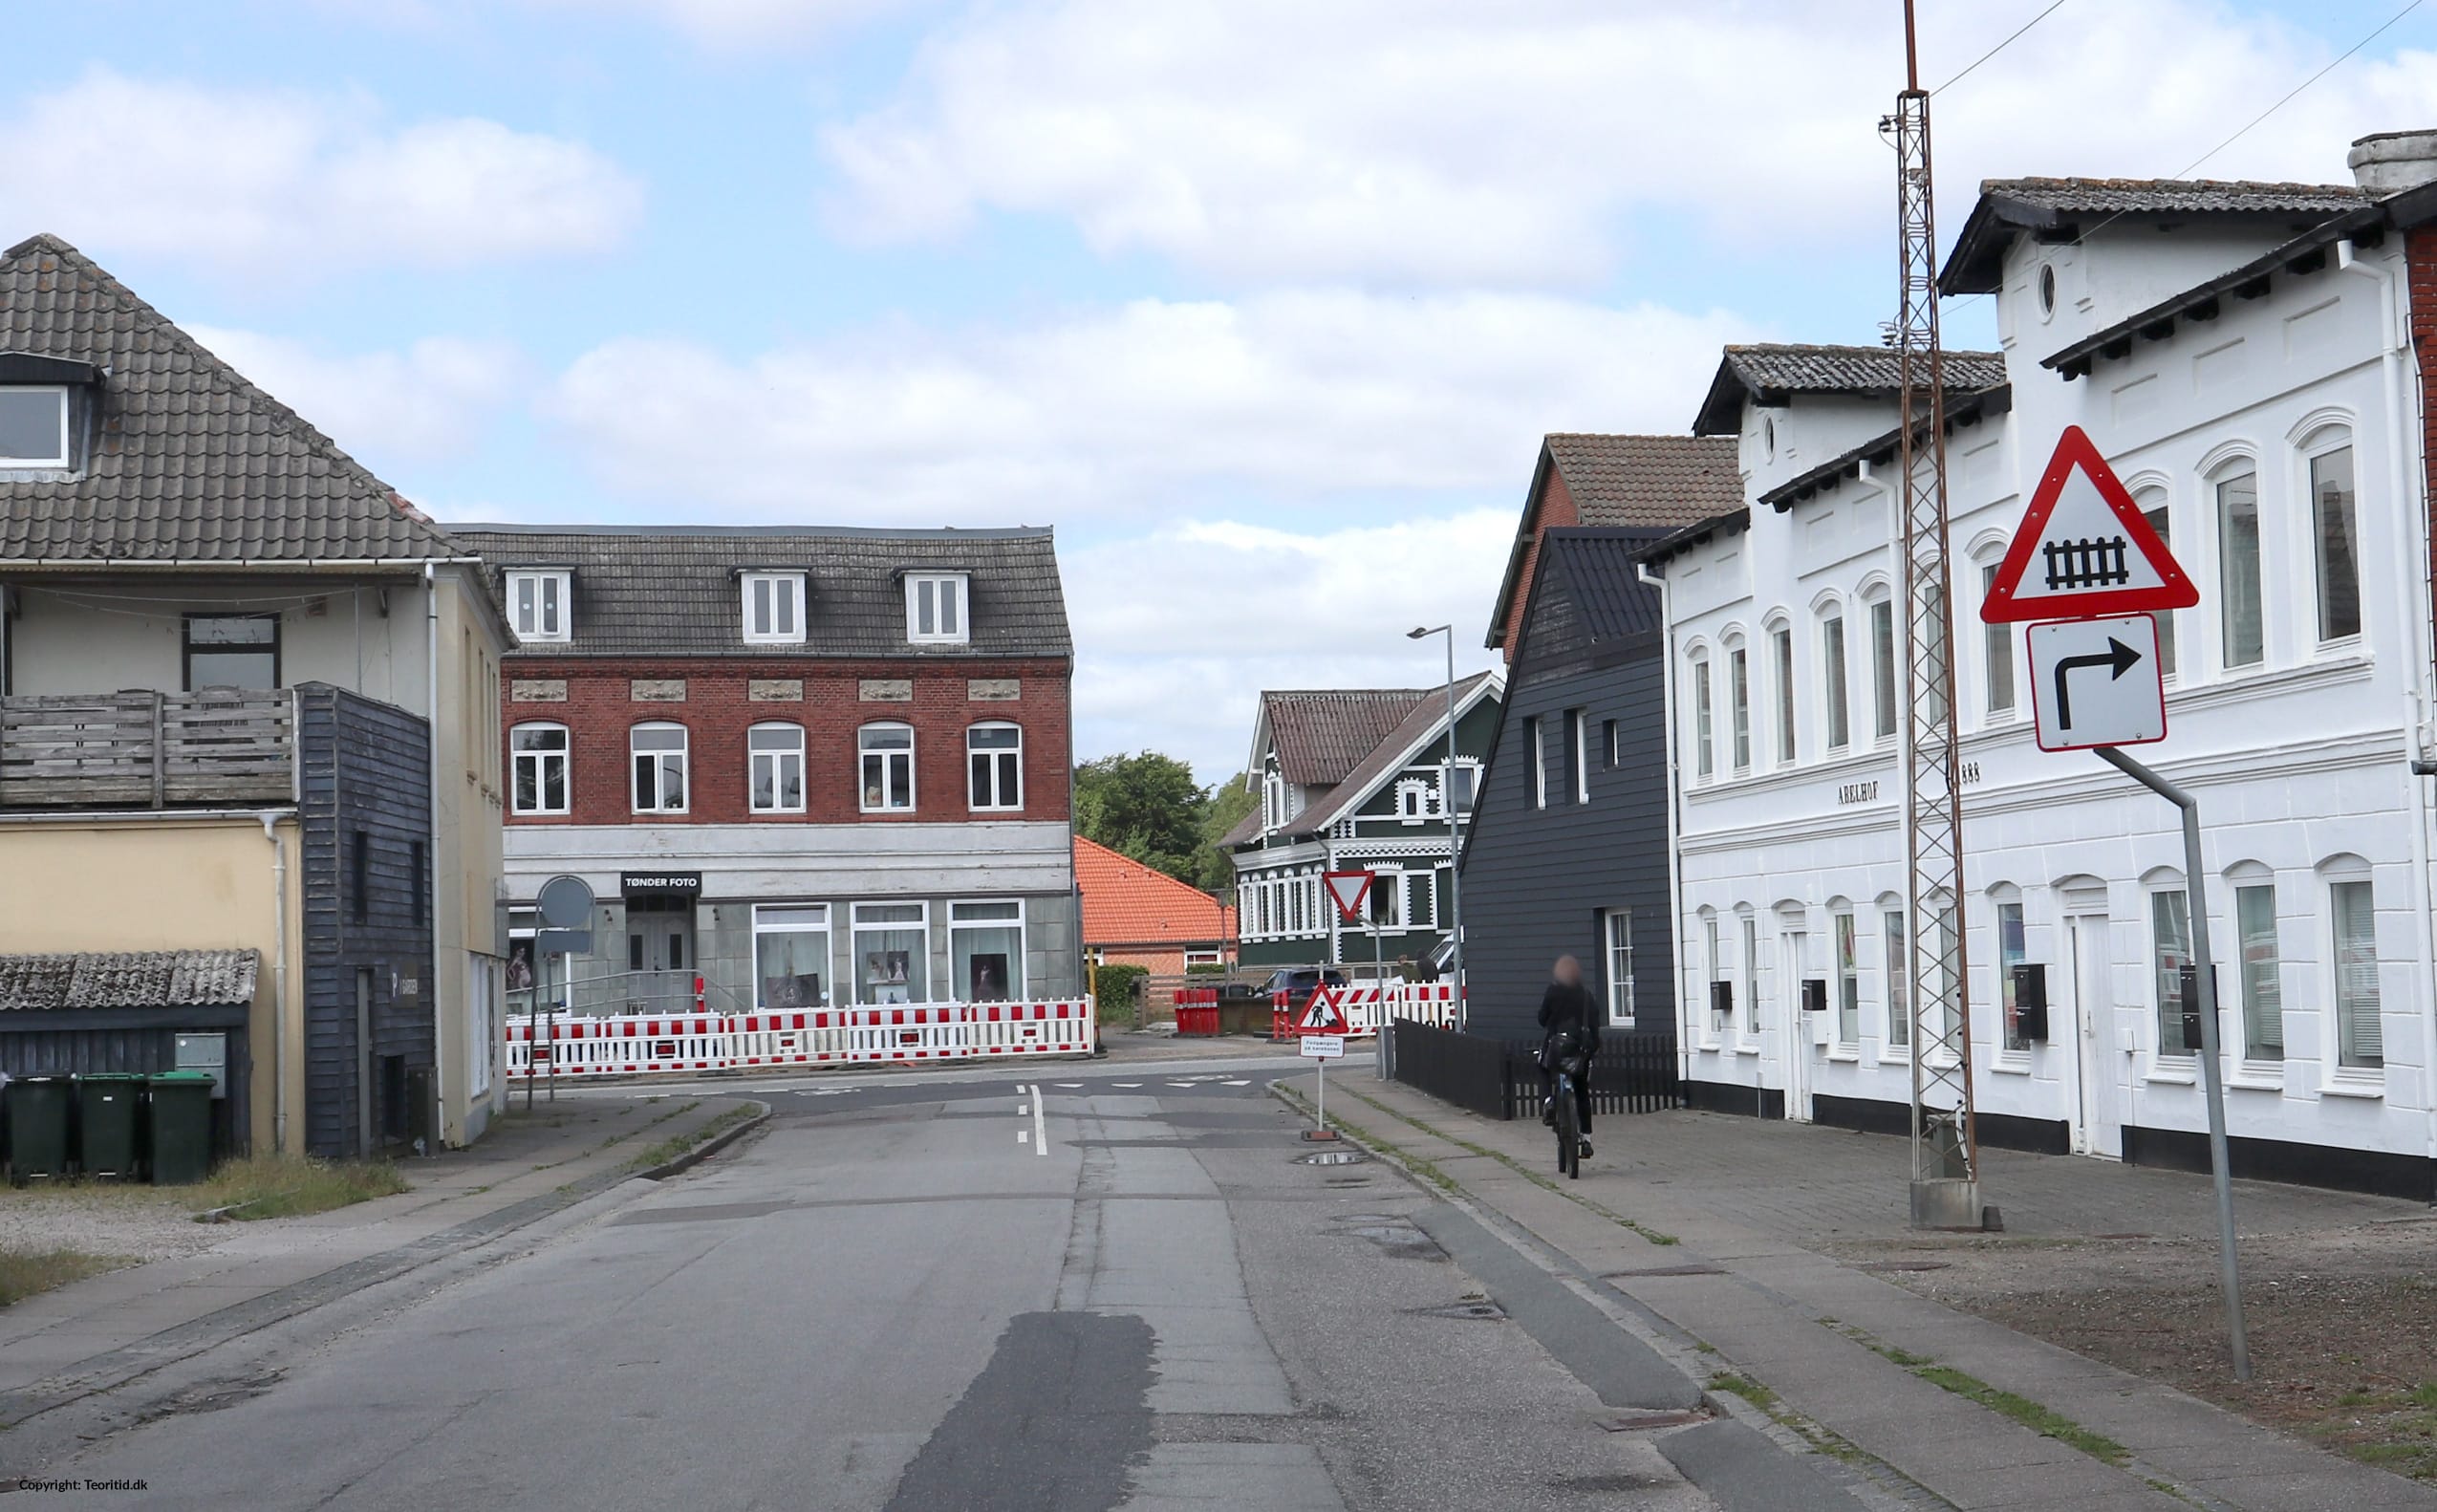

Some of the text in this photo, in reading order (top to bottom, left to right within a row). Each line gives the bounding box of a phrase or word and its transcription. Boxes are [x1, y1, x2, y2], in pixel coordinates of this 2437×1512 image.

[1838, 762, 1980, 805] ABELHOF 888
[625, 877, 698, 887] TØNDER FOTO
